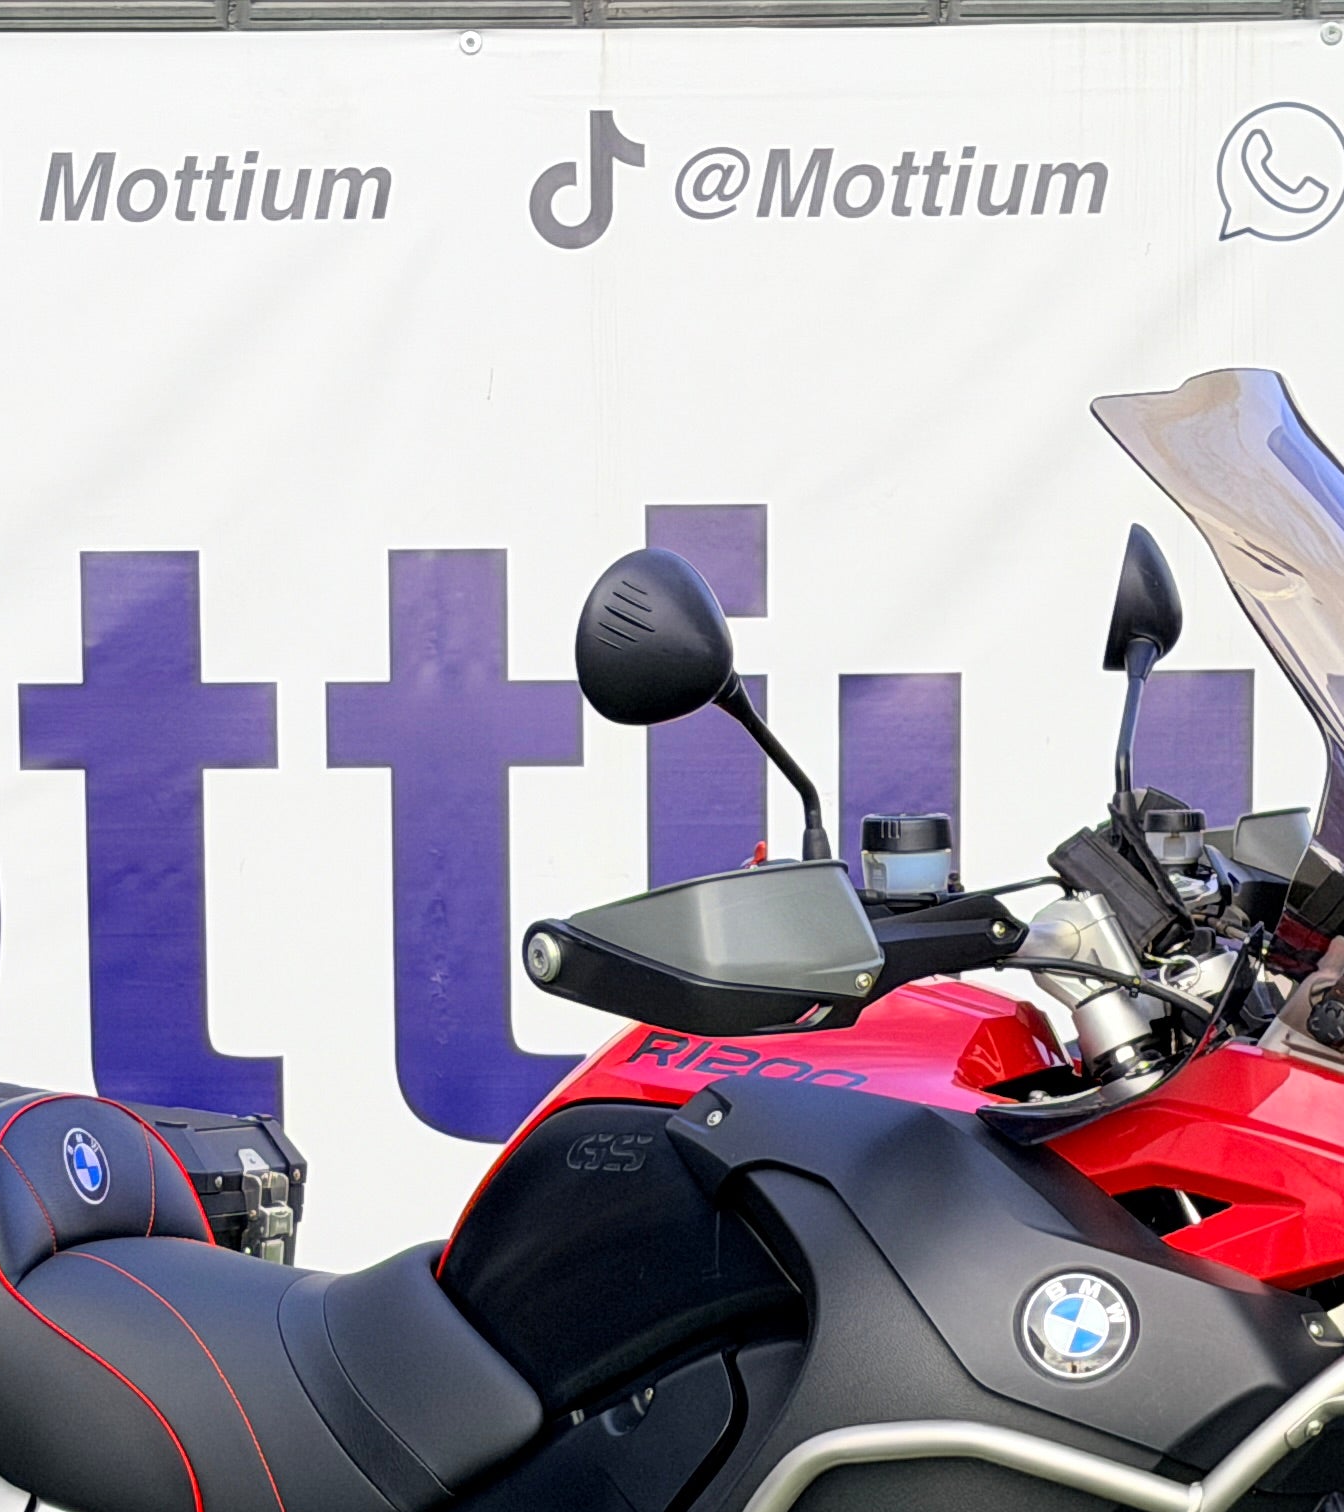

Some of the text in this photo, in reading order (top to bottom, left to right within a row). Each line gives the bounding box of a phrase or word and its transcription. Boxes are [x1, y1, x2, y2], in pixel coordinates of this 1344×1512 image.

[39, 150, 393, 223] Mottium
[674, 145, 1109, 220] @Mottium
[567, 1132, 654, 1171] GS
[1044, 1278, 1127, 1324] BMW
